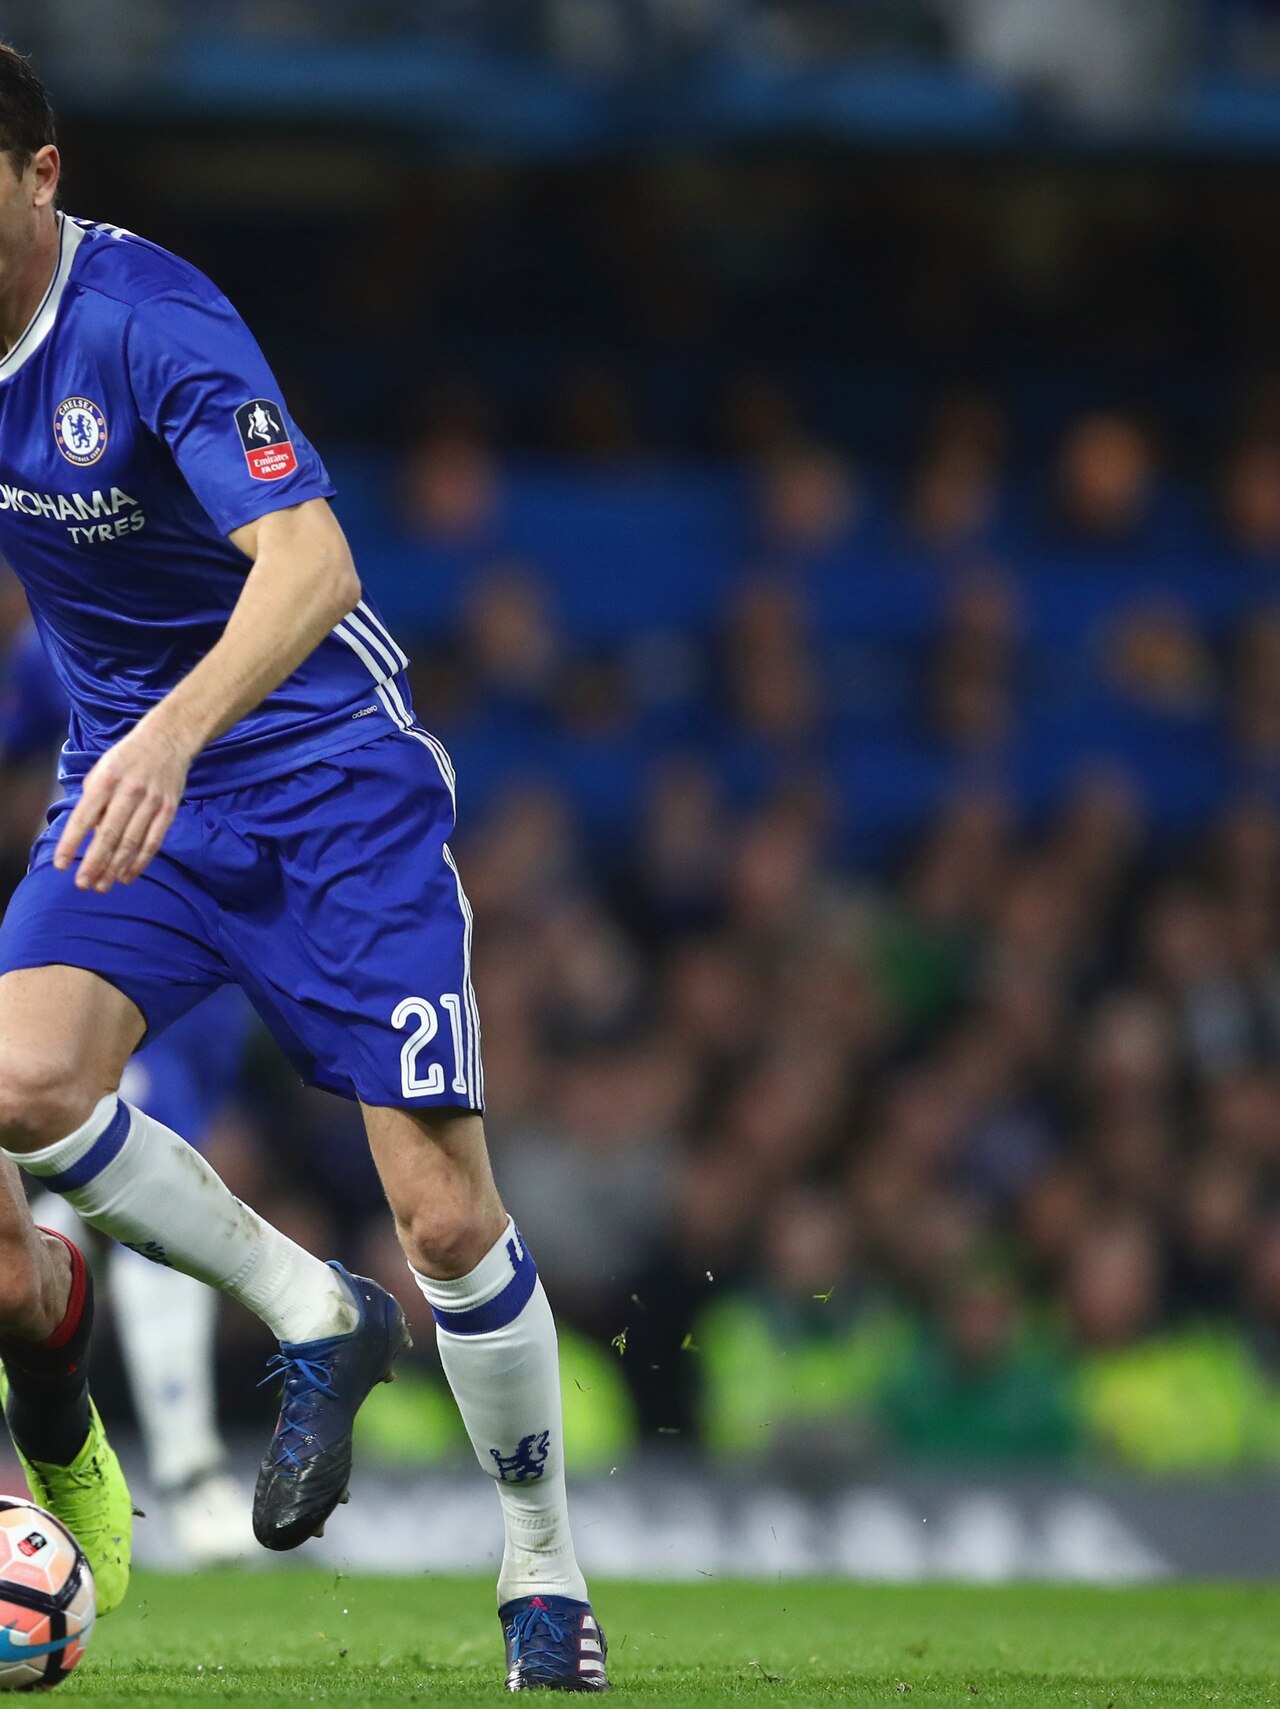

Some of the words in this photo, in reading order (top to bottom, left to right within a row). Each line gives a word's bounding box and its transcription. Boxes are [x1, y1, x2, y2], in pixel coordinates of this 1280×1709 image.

[59, 400, 94, 416] CHELSEA
[253, 453, 290, 468] Emirates
[67, 509, 146, 544] TYRES
[390, 993, 468, 1098] 21
